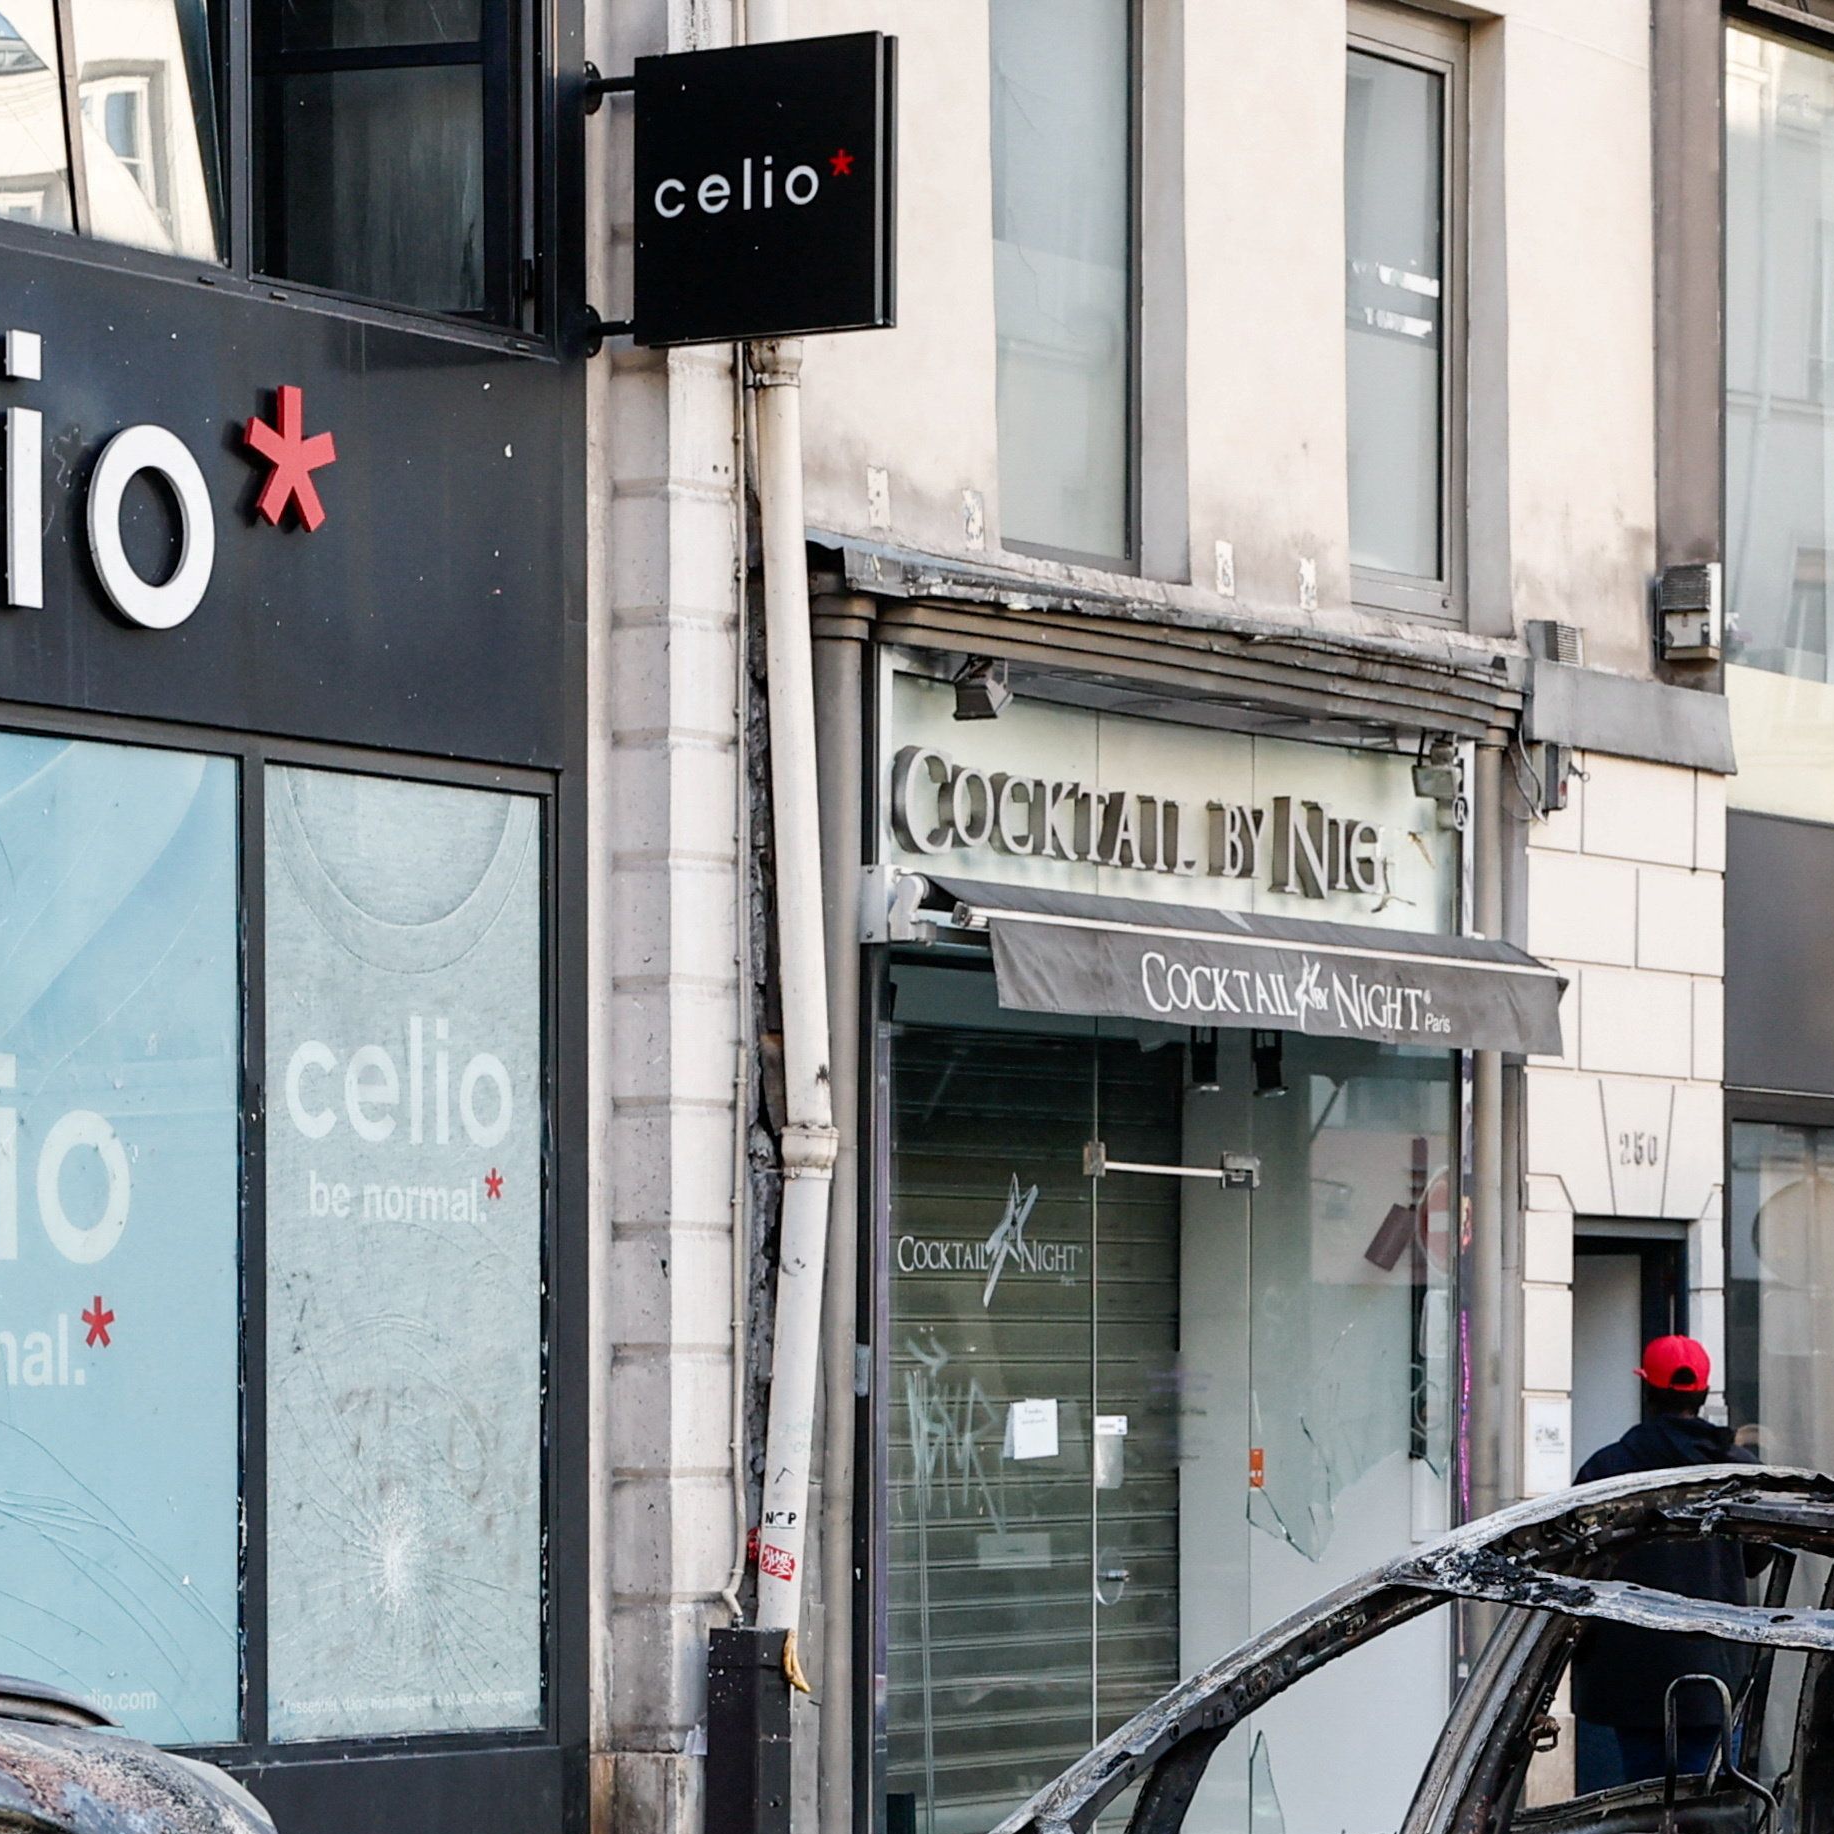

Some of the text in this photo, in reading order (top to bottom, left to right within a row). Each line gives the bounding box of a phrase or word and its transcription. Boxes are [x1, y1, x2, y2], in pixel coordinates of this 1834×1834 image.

[654, 155, 819, 219] celio
[893, 745, 1199, 877] COCKTAIL
[1208, 800, 1266, 878] BY
[1141, 952, 1297, 1017] COCKTAIL
[1333, 972, 1423, 1031] NIGHT
[1425, 1012, 1451, 1034] Paris
[286, 1016, 513, 1149] celio
[1619, 1131, 1658, 1167] 250
[310, 1170, 487, 1224] be normal.
[897, 1235, 1078, 1273] COCKTAIL NIGHT
